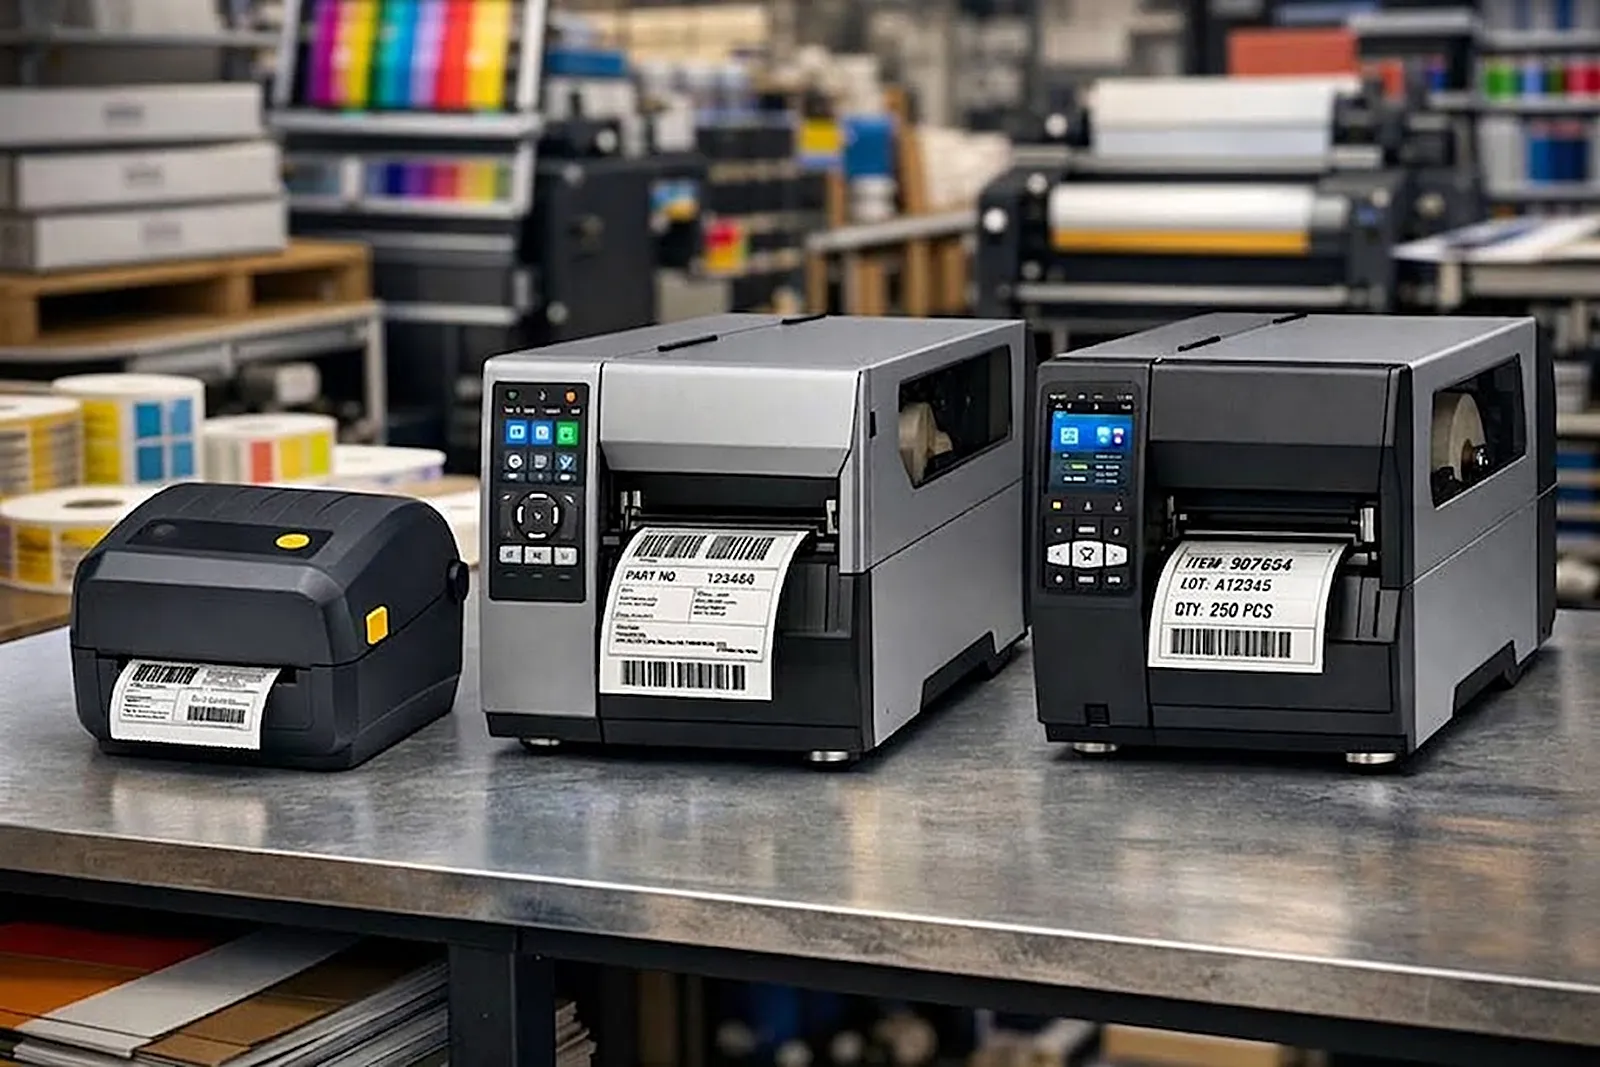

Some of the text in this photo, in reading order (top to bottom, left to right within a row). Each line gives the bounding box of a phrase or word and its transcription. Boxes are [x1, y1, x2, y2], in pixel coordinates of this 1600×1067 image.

[625, 570, 656, 581] PART
[1180, 577, 1272, 592] LOT: A12345
[1175, 602, 1273, 619] QTY: 250 PCS
